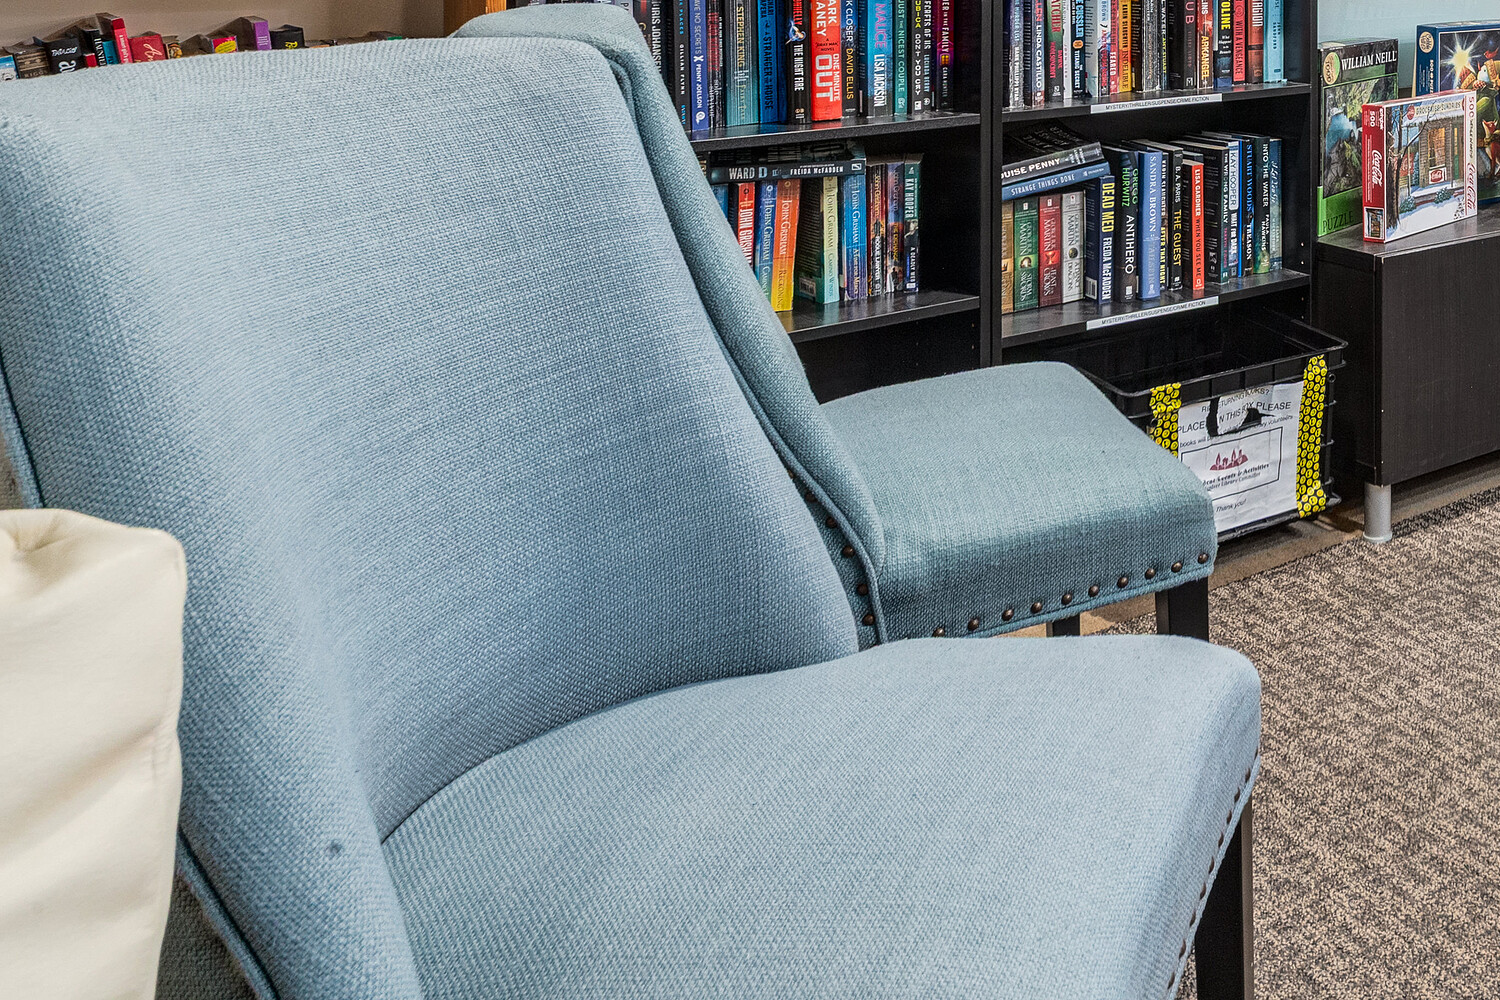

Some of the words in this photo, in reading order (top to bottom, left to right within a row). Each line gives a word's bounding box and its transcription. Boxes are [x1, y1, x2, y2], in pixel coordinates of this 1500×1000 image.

[1341, 54, 1374, 71] WILLIAM
[1375, 50, 1397, 64] NEILL
[815, 54, 834, 102] OUT
[1191, 95, 1210, 103] FICTION
[1102, 182, 1115, 209] DEAD
[1102, 212, 1115, 233] MED
[1174, 209, 1182, 230] THE
[1322, 210, 1354, 233] PUZZLE
[1125, 215, 1135, 275] ANTIHERO
[1173, 232, 1181, 267] GUEST
[1256, 402, 1291, 413] PLEASE
